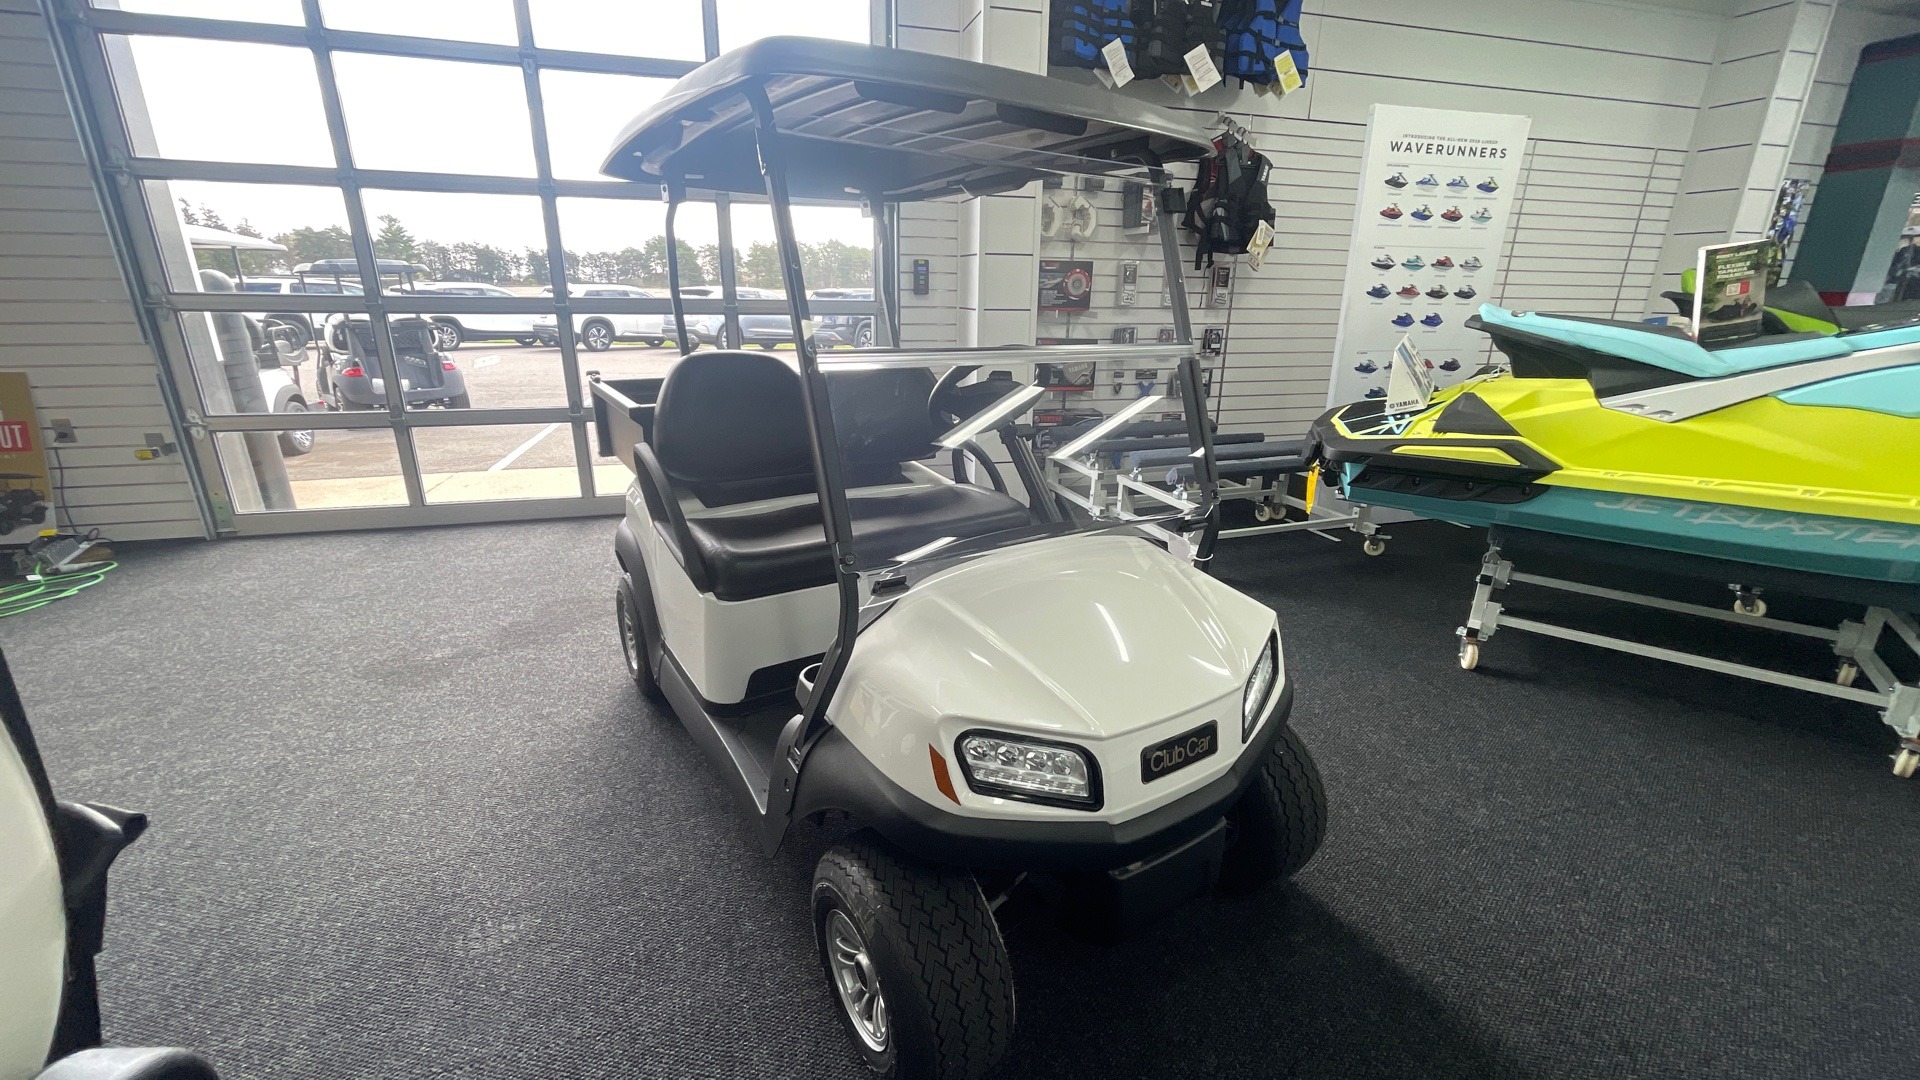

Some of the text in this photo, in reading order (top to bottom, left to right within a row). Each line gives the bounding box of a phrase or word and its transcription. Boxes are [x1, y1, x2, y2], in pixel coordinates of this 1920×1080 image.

[1390, 140, 1507, 158] WAVERUNNERS
[1395, 399, 1420, 408] YAMAHA
[1150, 735, 1211, 772] Club Car
